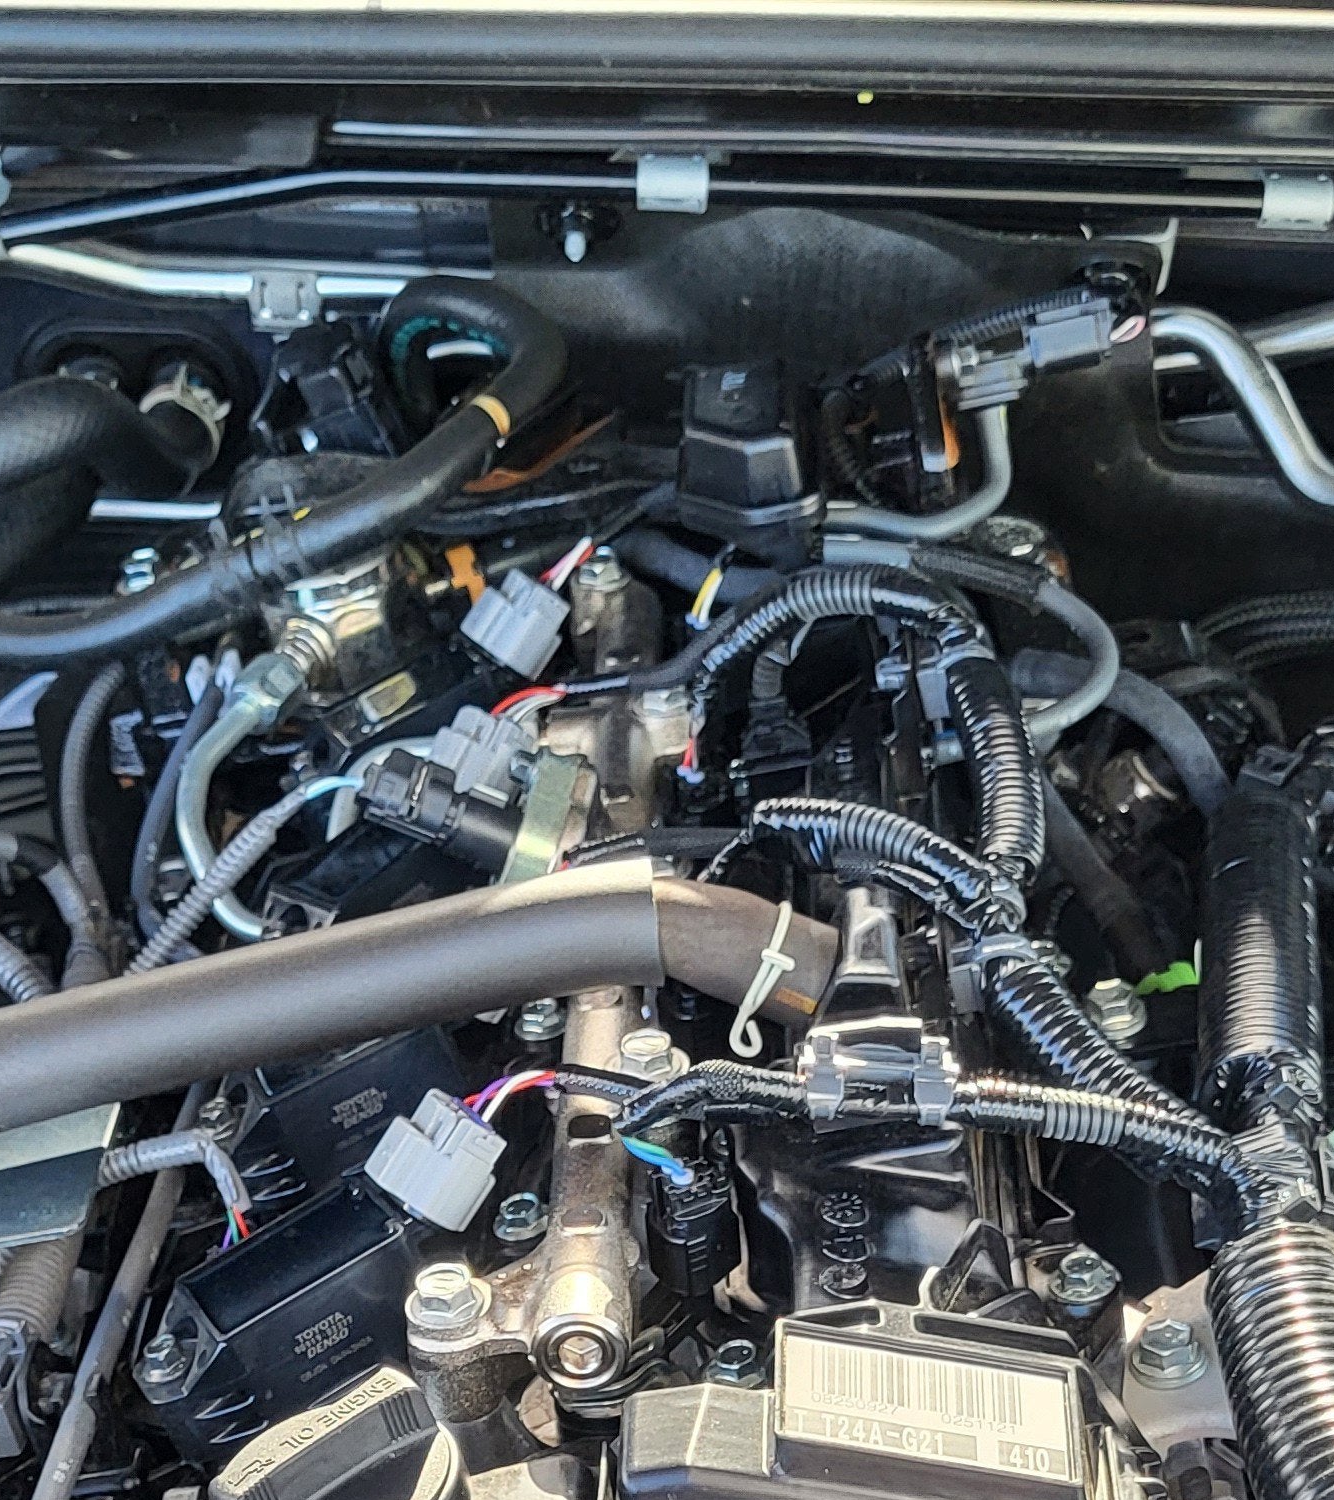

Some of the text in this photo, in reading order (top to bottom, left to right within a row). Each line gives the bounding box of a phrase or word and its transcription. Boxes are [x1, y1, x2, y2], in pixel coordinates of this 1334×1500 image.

[294, 1311, 344, 1343] TOYOTA
[307, 1327, 349, 1360] DENSO
[279, 1376, 397, 1450] ENGINE OIL
[821, 1413, 944, 1456] T24A-G21
[1008, 1444, 1050, 1473] 410
